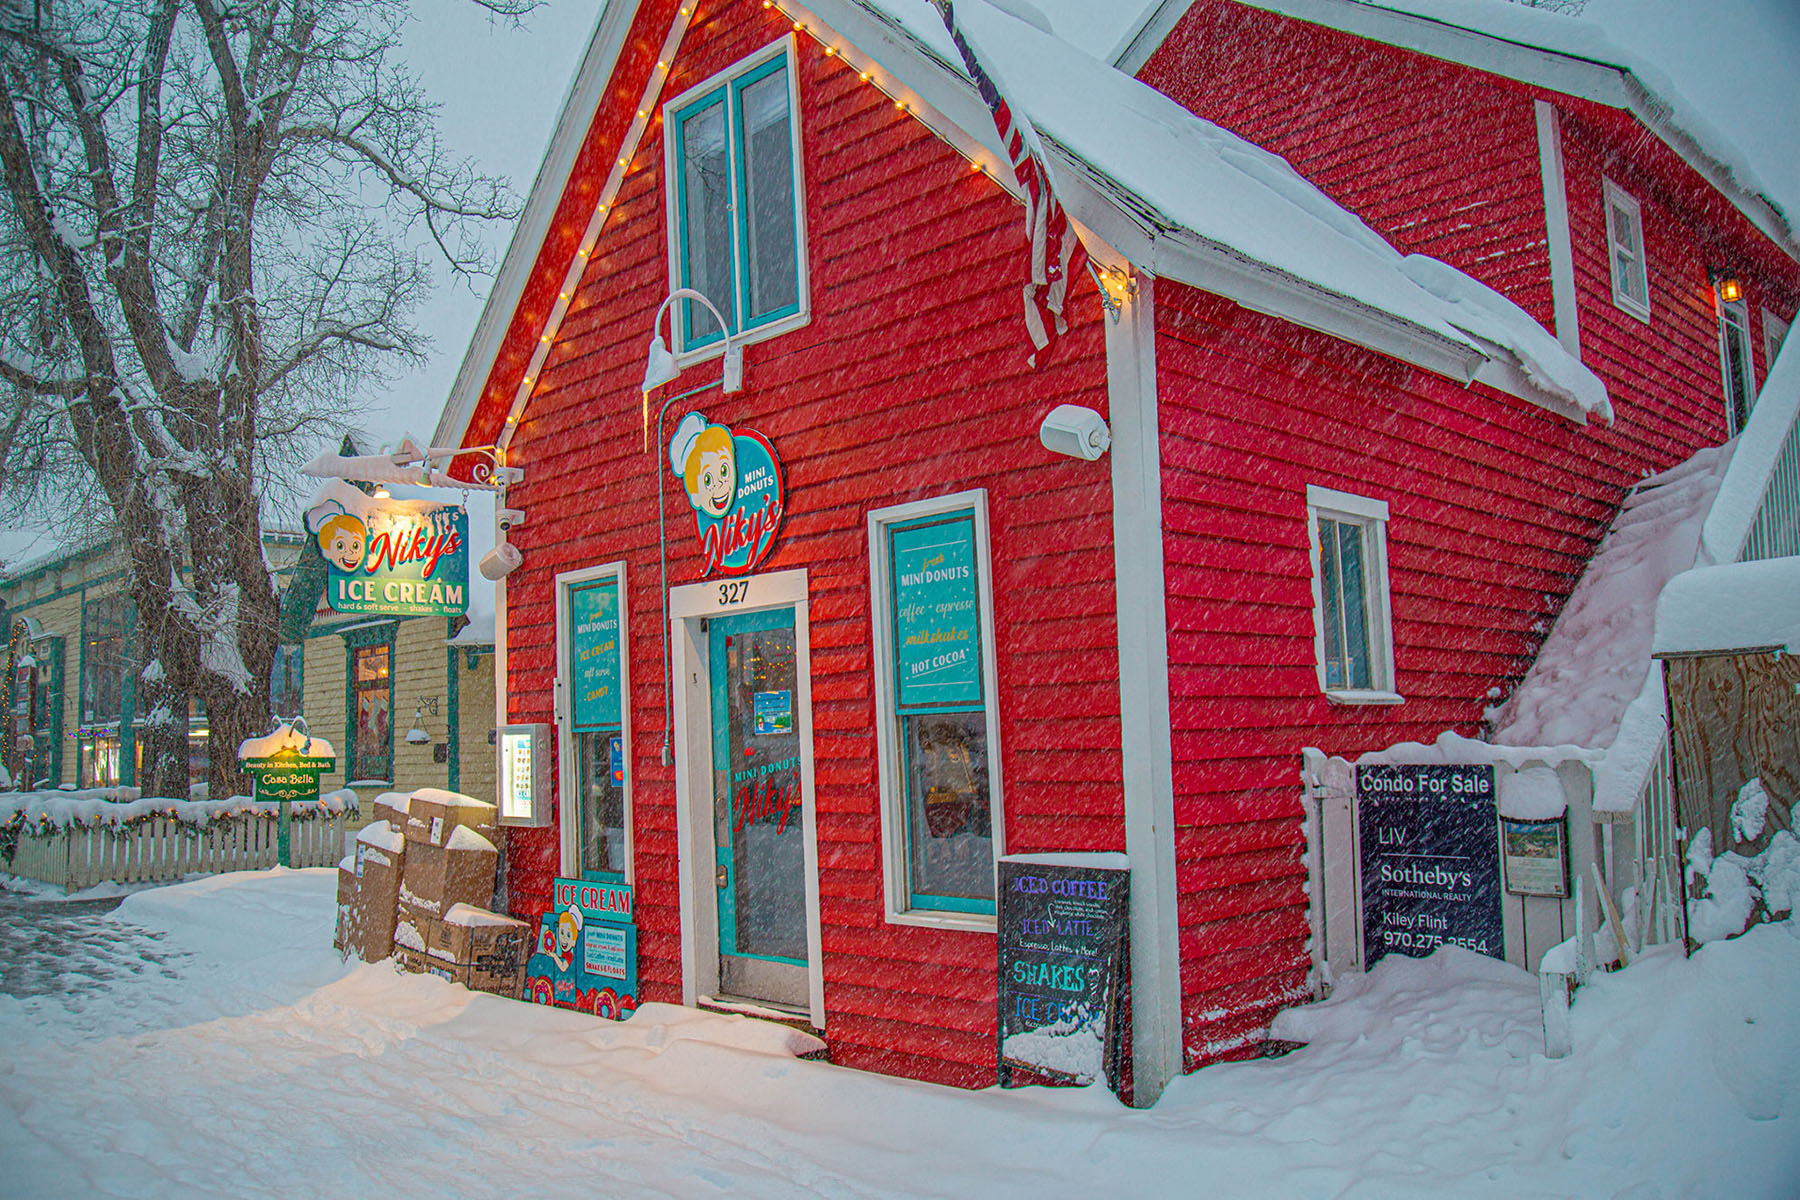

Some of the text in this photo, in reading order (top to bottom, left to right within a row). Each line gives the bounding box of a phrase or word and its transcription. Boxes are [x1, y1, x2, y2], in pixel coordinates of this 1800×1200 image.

[744, 467, 766, 484] MINI
[737, 475, 775, 499] DONUTS
[700, 494, 782, 577] Niky's
[365, 525, 462, 580] Niky's
[922, 552, 945, 574] fresh
[901, 566, 969, 587] MINI DONUTS
[338, 579, 463, 605] ICE CREAM
[719, 581, 749, 606] 327
[338, 602, 355, 610] hard
[363, 603, 378, 611] soft
[379, 604, 399, 612] serve
[442, 606, 462, 614] floats
[899, 603, 925, 623] coffee
[935, 600, 974, 619] espresso
[577, 619, 617, 634] MINI DONUTS
[905, 626, 969, 646] milkshakes
[580, 640, 614, 662] ICE CREAM
[911, 649, 966, 674] HOT COCOA
[586, 685, 609, 701] CANDY
[262, 774, 314, 785] Casa Bella
[734, 755, 800, 782] MINI DONUTS
[1361, 774, 1490, 794] Condo For Sale
[732, 771, 802, 836] Niky's
[1378, 827, 1407, 845] LIV
[1014, 876, 1108, 900] ICED COFFEE
[1380, 865, 1472, 890] Sotheby's
[557, 884, 630, 914] ICE CREAM
[1381, 888, 1472, 902] INTERNATIONAL REALTY
[1023, 918, 1094, 936] ICED LATTE
[1382, 911, 1448, 930] Kiley Flint
[1013, 960, 1085, 992] SHAKES
[1015, 996, 1041, 1021] ICE
